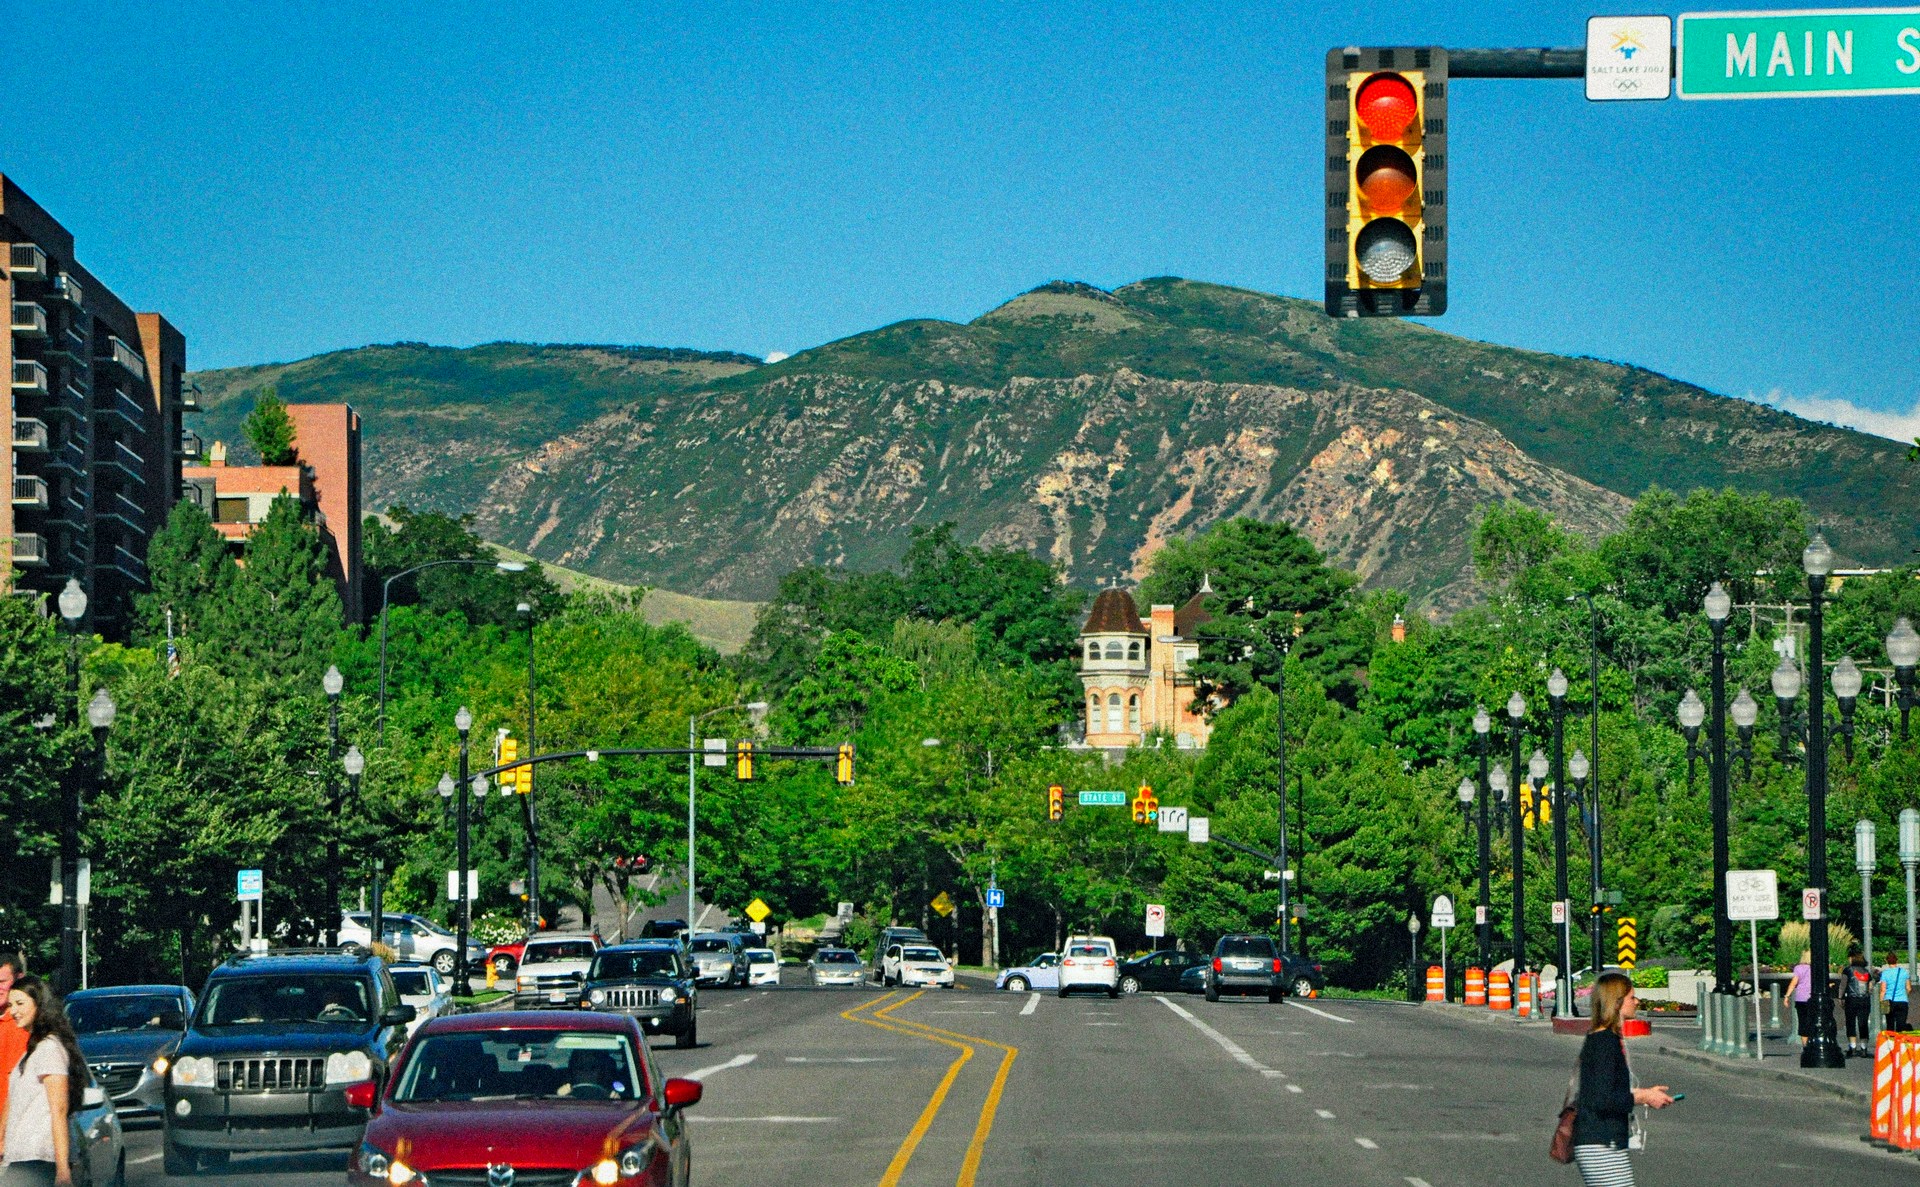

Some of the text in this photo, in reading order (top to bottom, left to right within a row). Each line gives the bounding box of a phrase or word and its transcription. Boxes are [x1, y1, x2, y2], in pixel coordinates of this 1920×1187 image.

[1725, 27, 1920, 78] MAIN S
[1591, 66, 1613, 74] SALT
[1616, 66, 1639, 74] LAKE
[1083, 793, 1107, 802] STATE
[990, 891, 1000, 904] H
[1732, 894, 1752, 902] MAY
